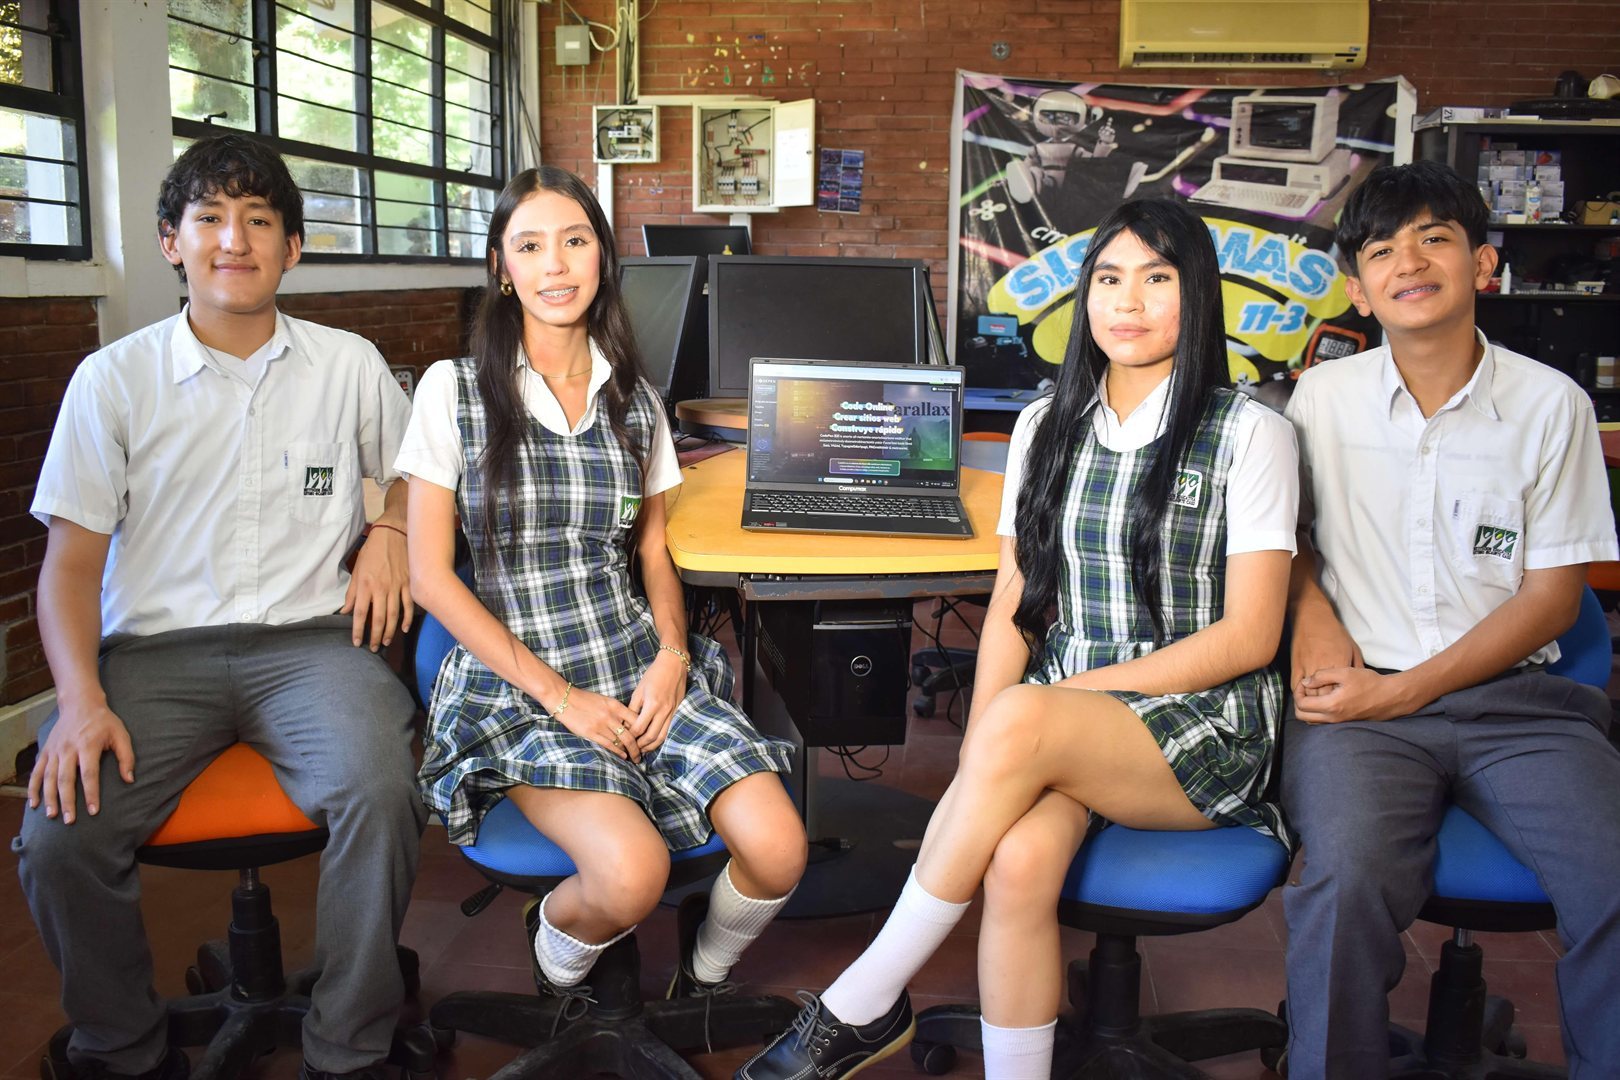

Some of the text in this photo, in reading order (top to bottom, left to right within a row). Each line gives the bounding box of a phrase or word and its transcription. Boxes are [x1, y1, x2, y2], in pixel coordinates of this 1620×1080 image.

[1240, 303, 1306, 332] 11-3
[841, 401, 895, 412] Code Online
[892, 402, 951, 417] arallax
[833, 412, 902, 423] Crear sitios web
[830, 423, 903, 436] Construye rápido
